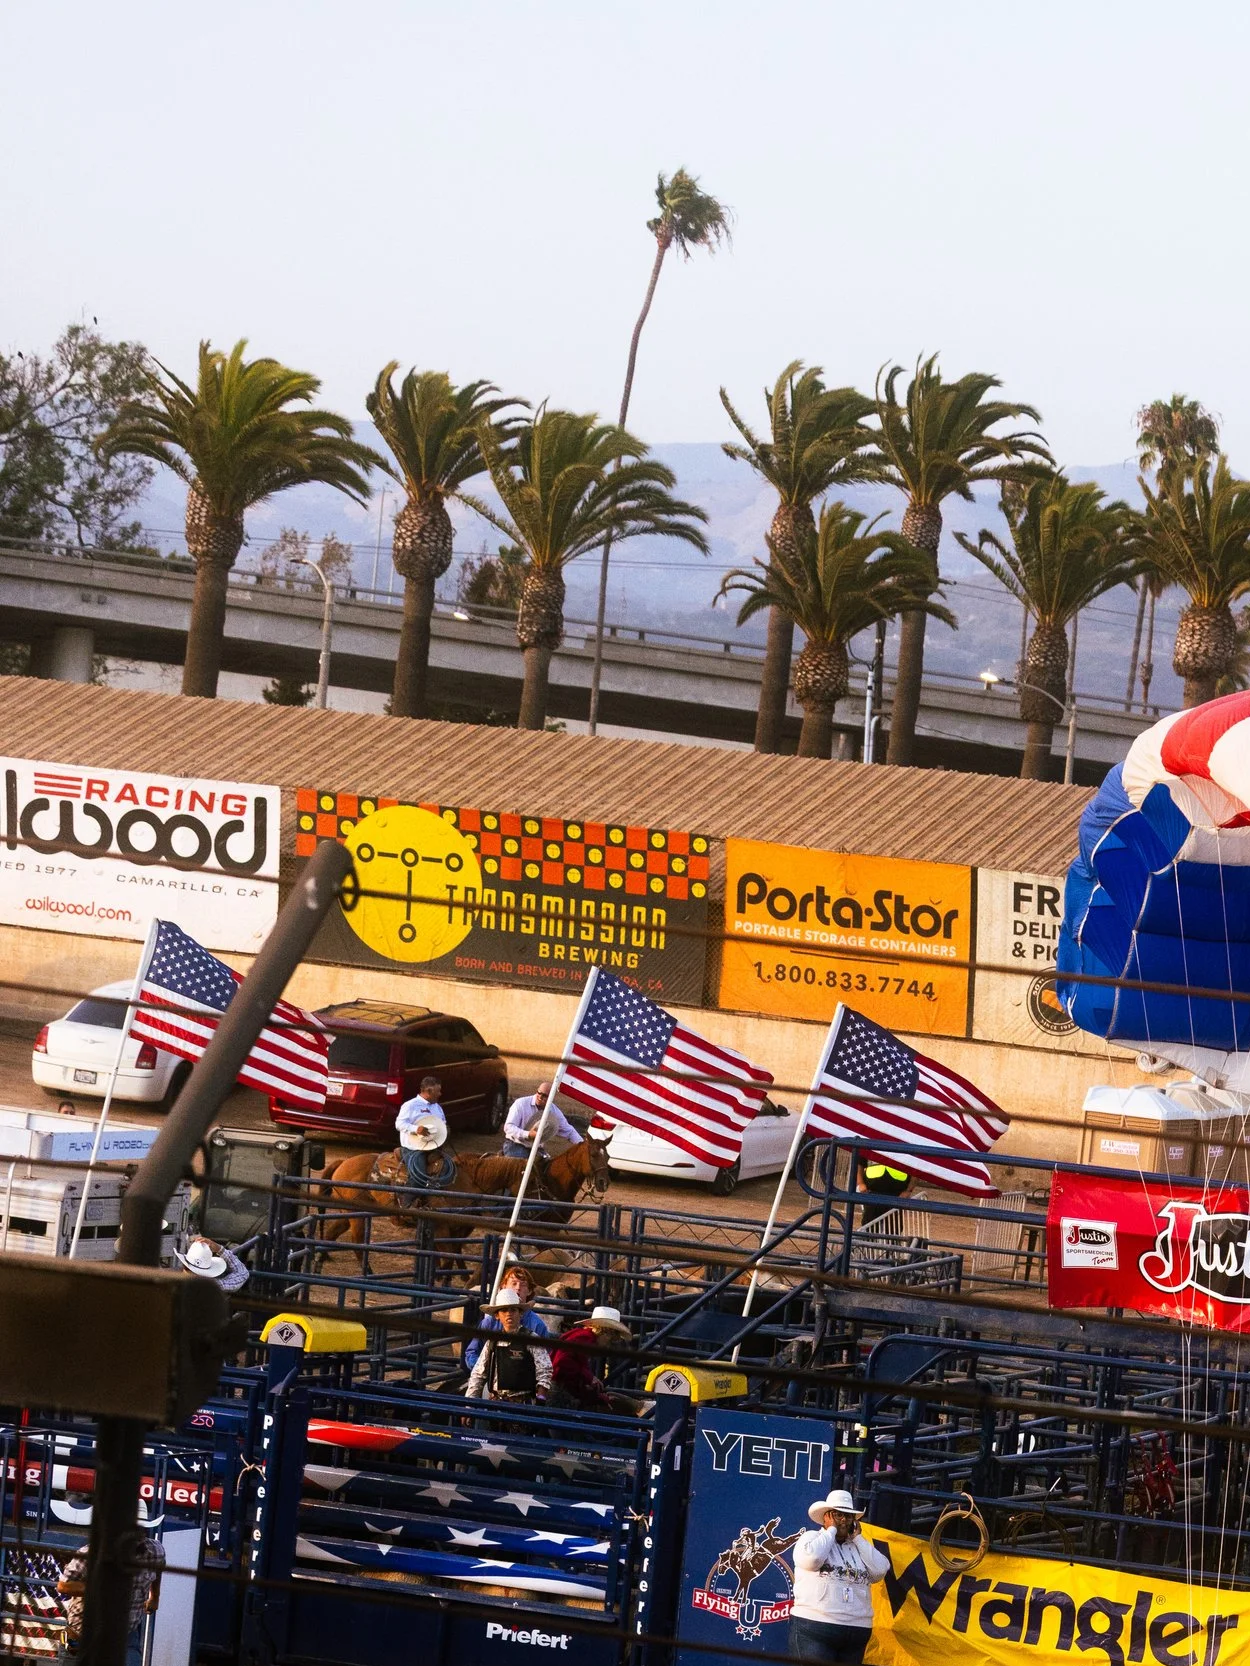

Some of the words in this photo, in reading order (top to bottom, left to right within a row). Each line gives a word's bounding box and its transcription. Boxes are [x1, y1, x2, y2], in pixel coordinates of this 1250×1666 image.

[84, 777, 248, 817] RACING
[5, 769, 268, 875] lwood
[0, 861, 25, 871] ED
[34, 864, 78, 877] 1977
[116, 873, 228, 896] CAMARILLO,
[236, 887, 259, 898] CA
[1013, 881, 1061, 918] FR
[25, 896, 132, 922] wilwood.com
[734, 920, 801, 940] PORTABLE
[804, 929, 866, 948] STORAGE
[870, 937, 957, 958] CONTAINERS
[1012, 942, 1027, 958] &
[455, 956, 485, 970] BORN
[489, 962, 513, 973] AND
[517, 964, 566, 979] BREWED
[570, 971, 582, 981] IN
[538, 942, 640, 969] BREWING
[753, 961, 935, 999] 1.800.833.7744
[69, 1141, 95, 1152] FLYIN
[1066, 1224, 1109, 1245] Justin
[701, 1429, 825, 1483] YETI
[694, 1590, 739, 1619] Flying
[762, 1604, 790, 1621] Rod
[486, 1621, 569, 1650] Priefert
